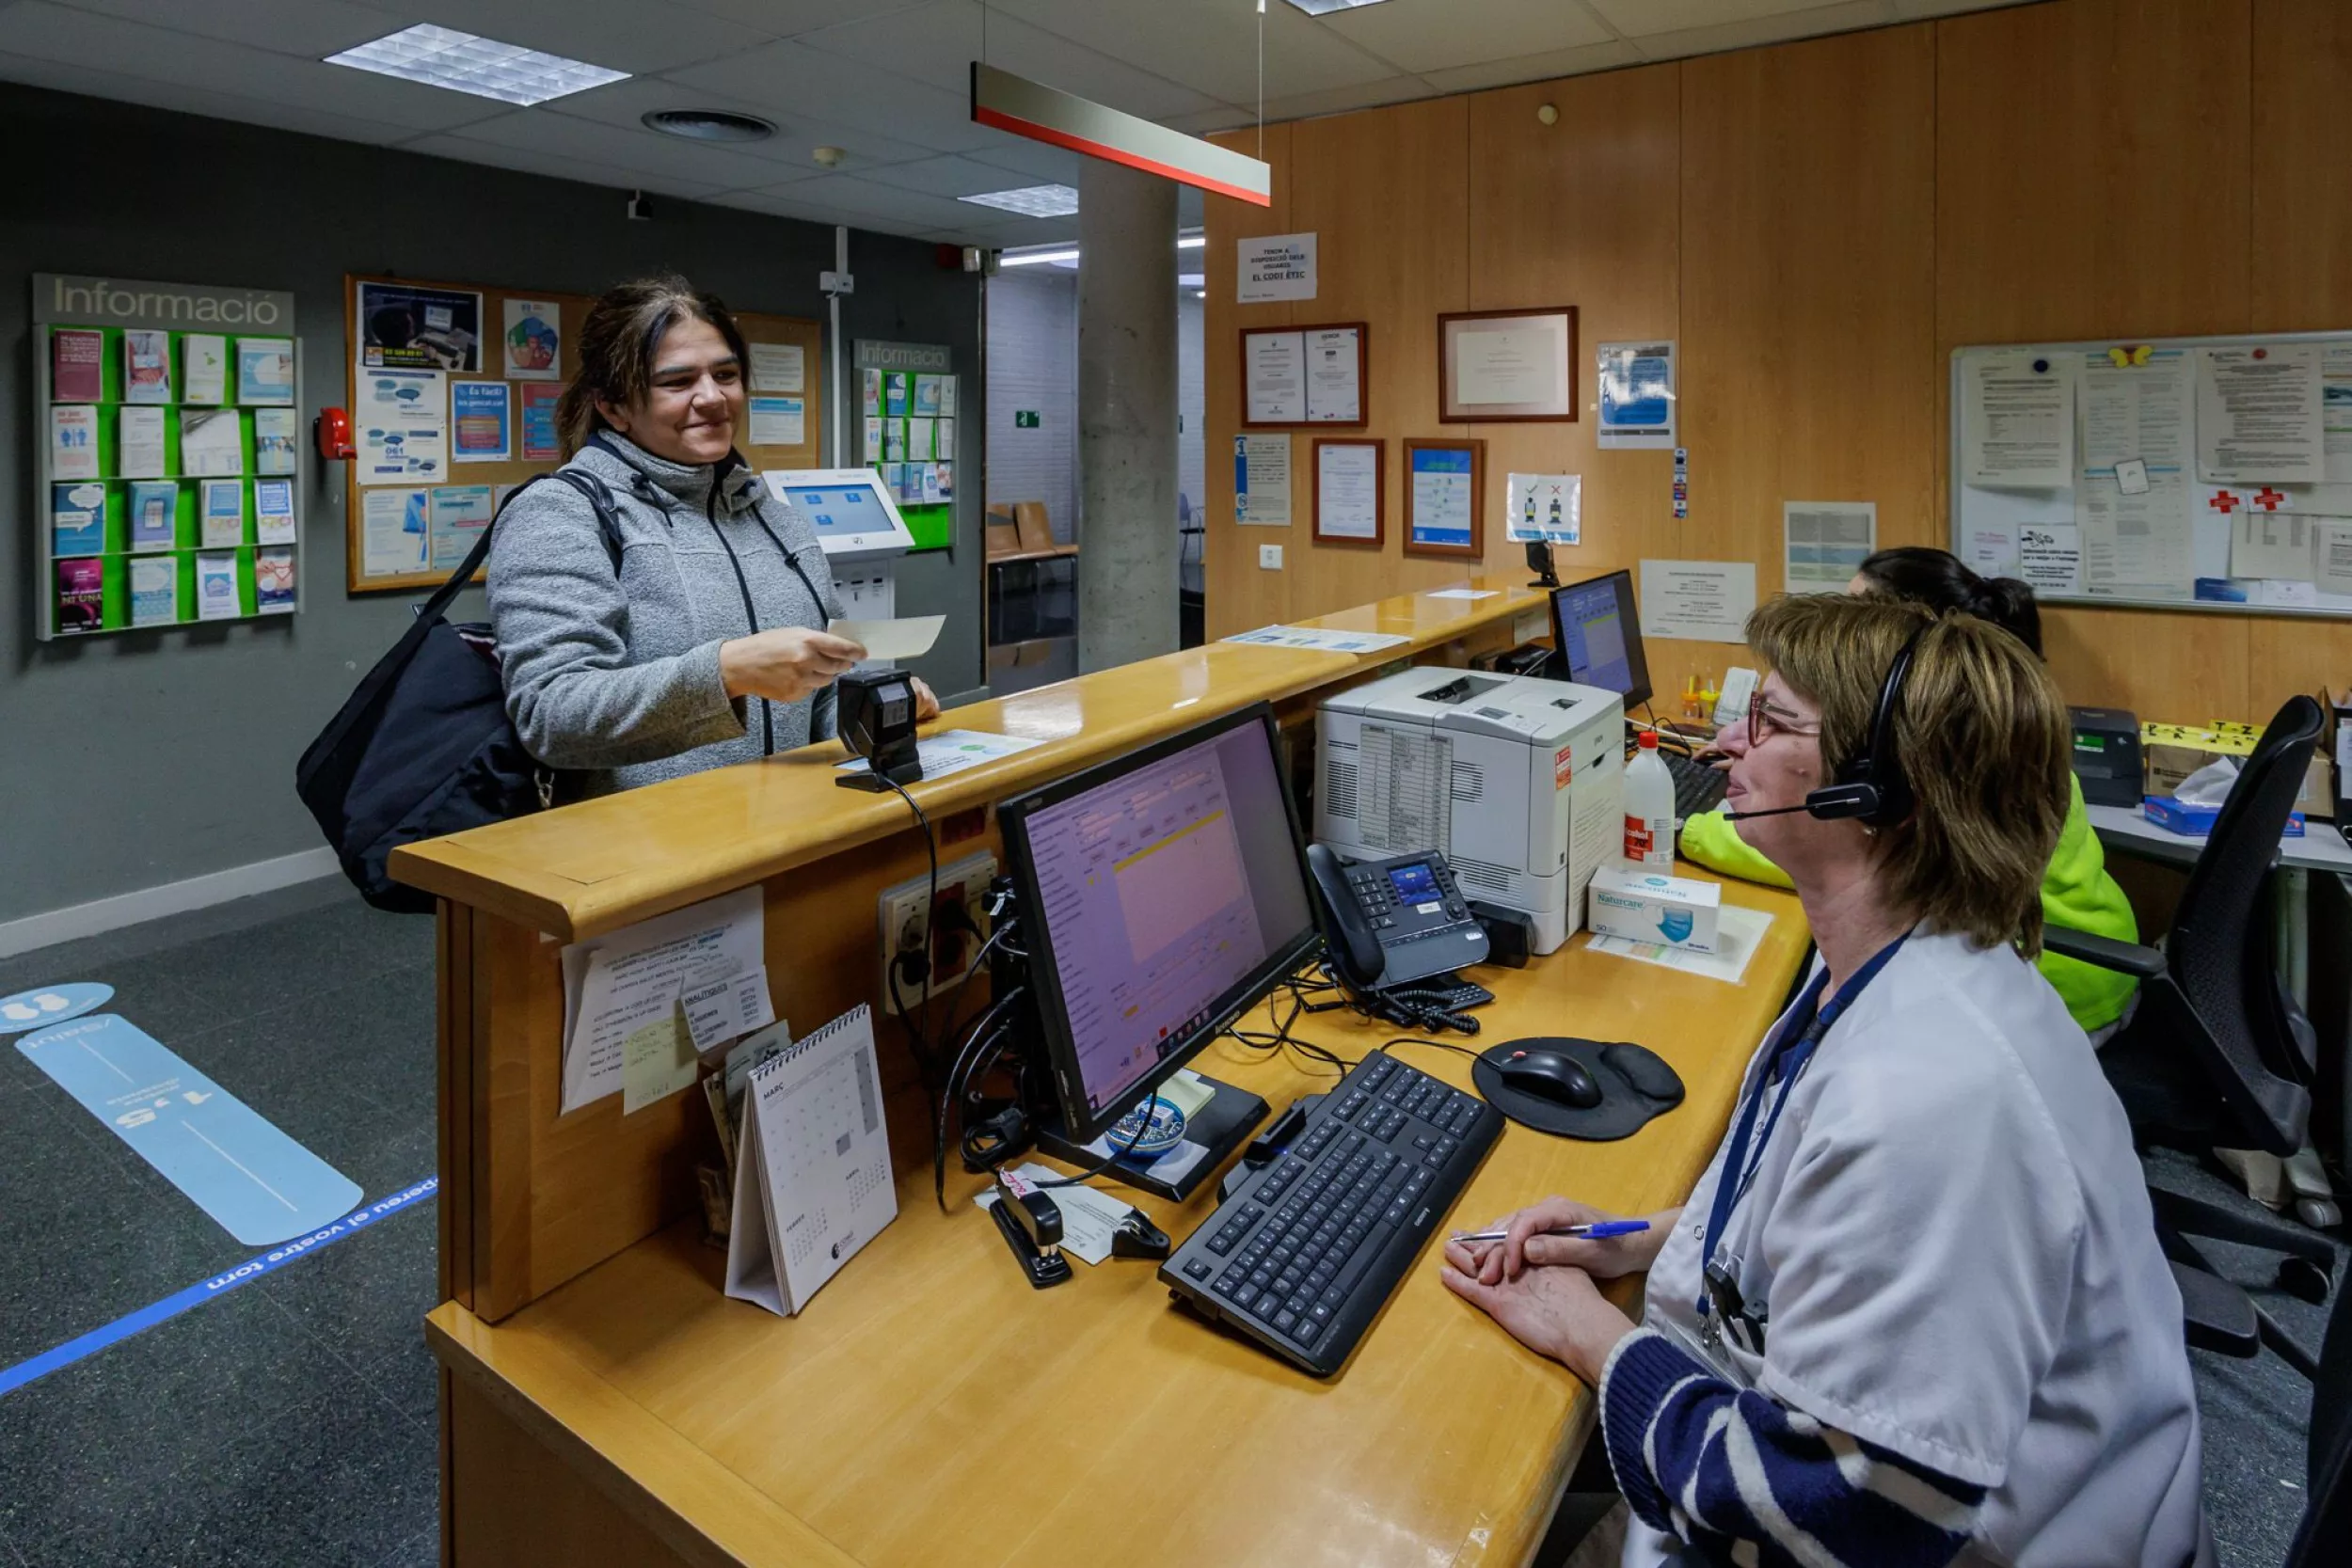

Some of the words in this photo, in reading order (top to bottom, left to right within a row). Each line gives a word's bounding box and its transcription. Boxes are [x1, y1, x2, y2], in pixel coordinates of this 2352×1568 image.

[1252, 274, 1263, 282] EL
[1263, 272, 1284, 281] CODI
[54, 277, 279, 325] Informació
[861, 342, 945, 368] Informació
[2215, 721, 2226, 731] T
[2241, 725, 2252, 735] Z
[1597, 893, 1645, 910] Naturcare
[373, 1175, 438, 1215] pereu
[346, 1210, 370, 1229] el
[267, 1221, 345, 1264] vostre
[206, 1261, 264, 1291] torn
